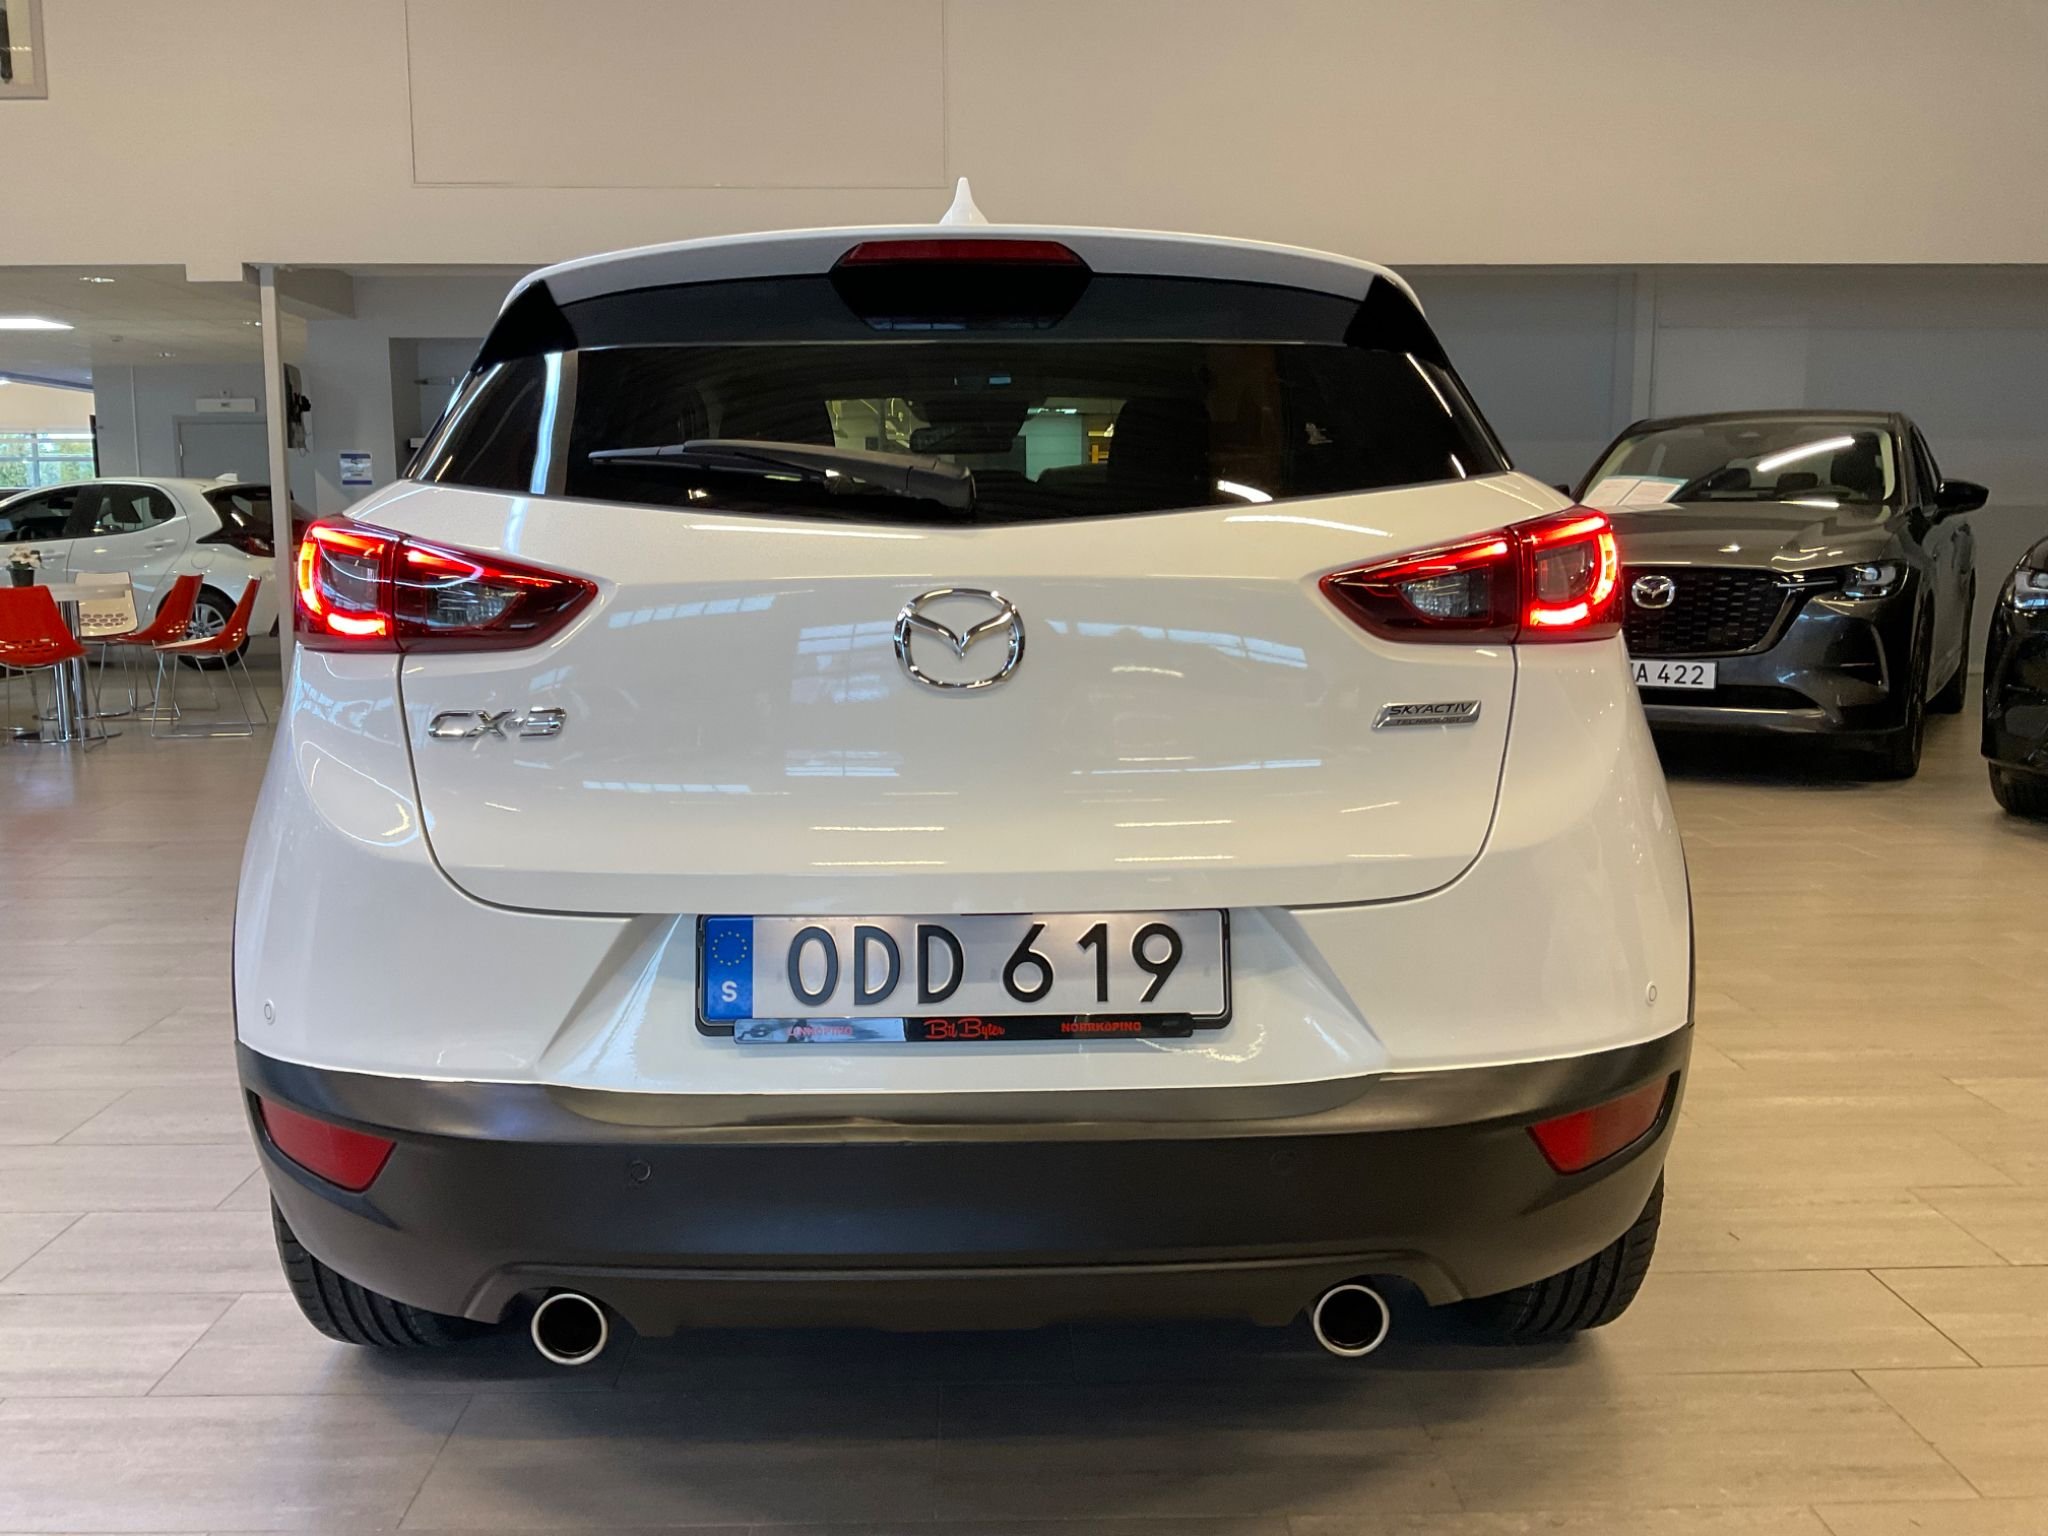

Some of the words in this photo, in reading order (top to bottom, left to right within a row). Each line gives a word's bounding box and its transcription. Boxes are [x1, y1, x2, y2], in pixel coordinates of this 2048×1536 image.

[1657, 664, 1704, 685] 422
[1388, 703, 1473, 716] SKYACTIV
[428, 706, 566, 738] CX-3
[787, 924, 964, 1005] ODD
[1002, 923, 1183, 1003] 619
[722, 981, 738, 1002] S
